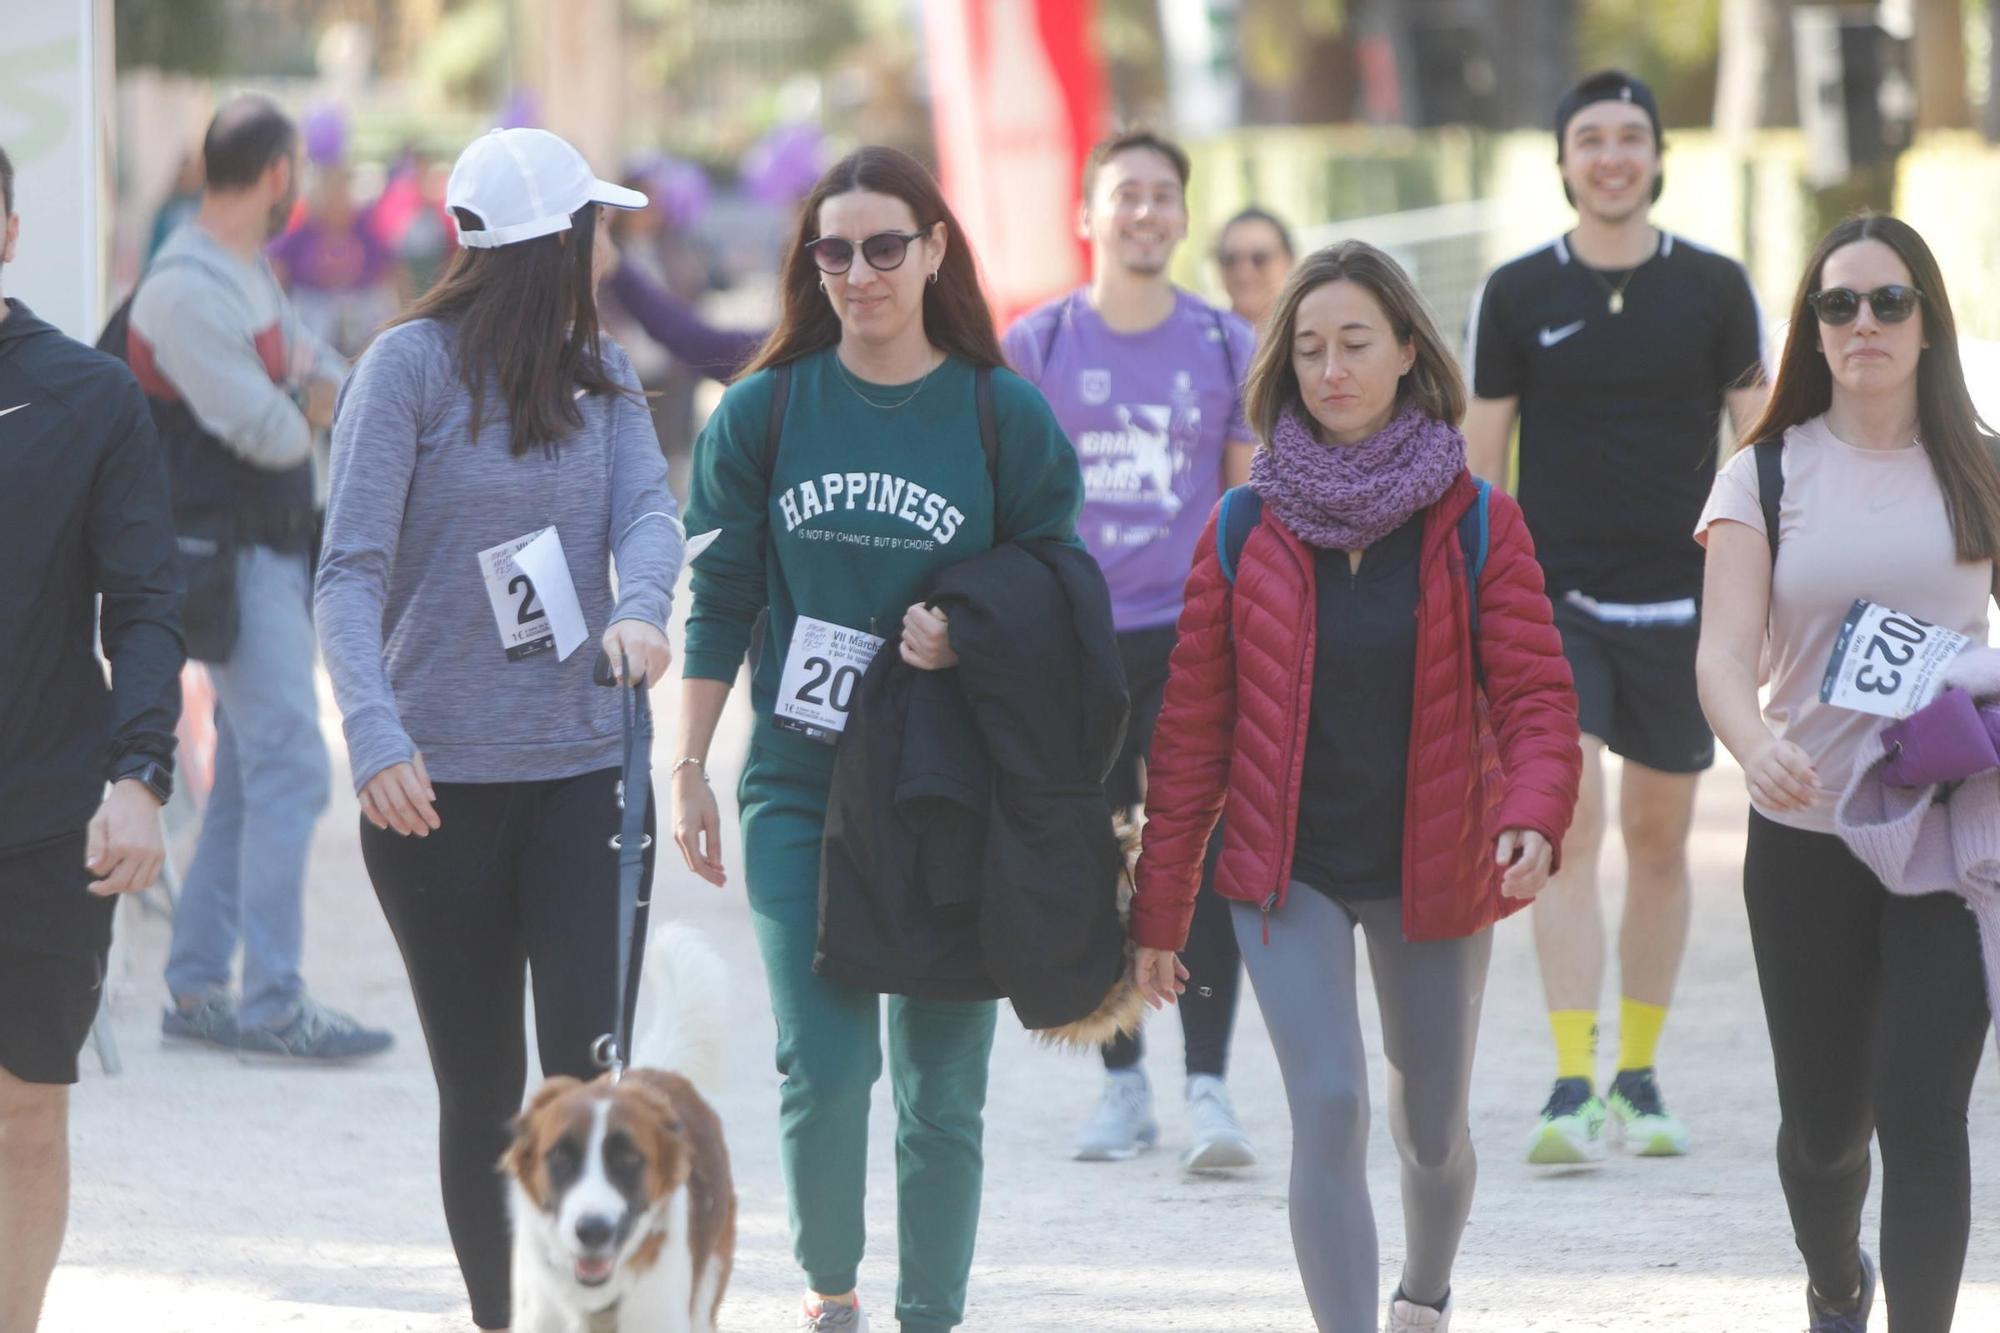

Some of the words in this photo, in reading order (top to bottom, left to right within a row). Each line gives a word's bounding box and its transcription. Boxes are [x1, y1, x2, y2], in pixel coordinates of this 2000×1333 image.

[778, 472, 966, 544] HAPPINESS
[806, 529, 823, 541] NOT
[824, 530, 836, 541] BY
[836, 532, 870, 546] CHANCE
[874, 536, 889, 547] BUT
[891, 537, 903, 548] BY
[903, 538, 935, 551] CHOISE
[508, 574, 546, 625] 2
[833, 630, 847, 641] VII
[1855, 609, 1934, 696] 023
